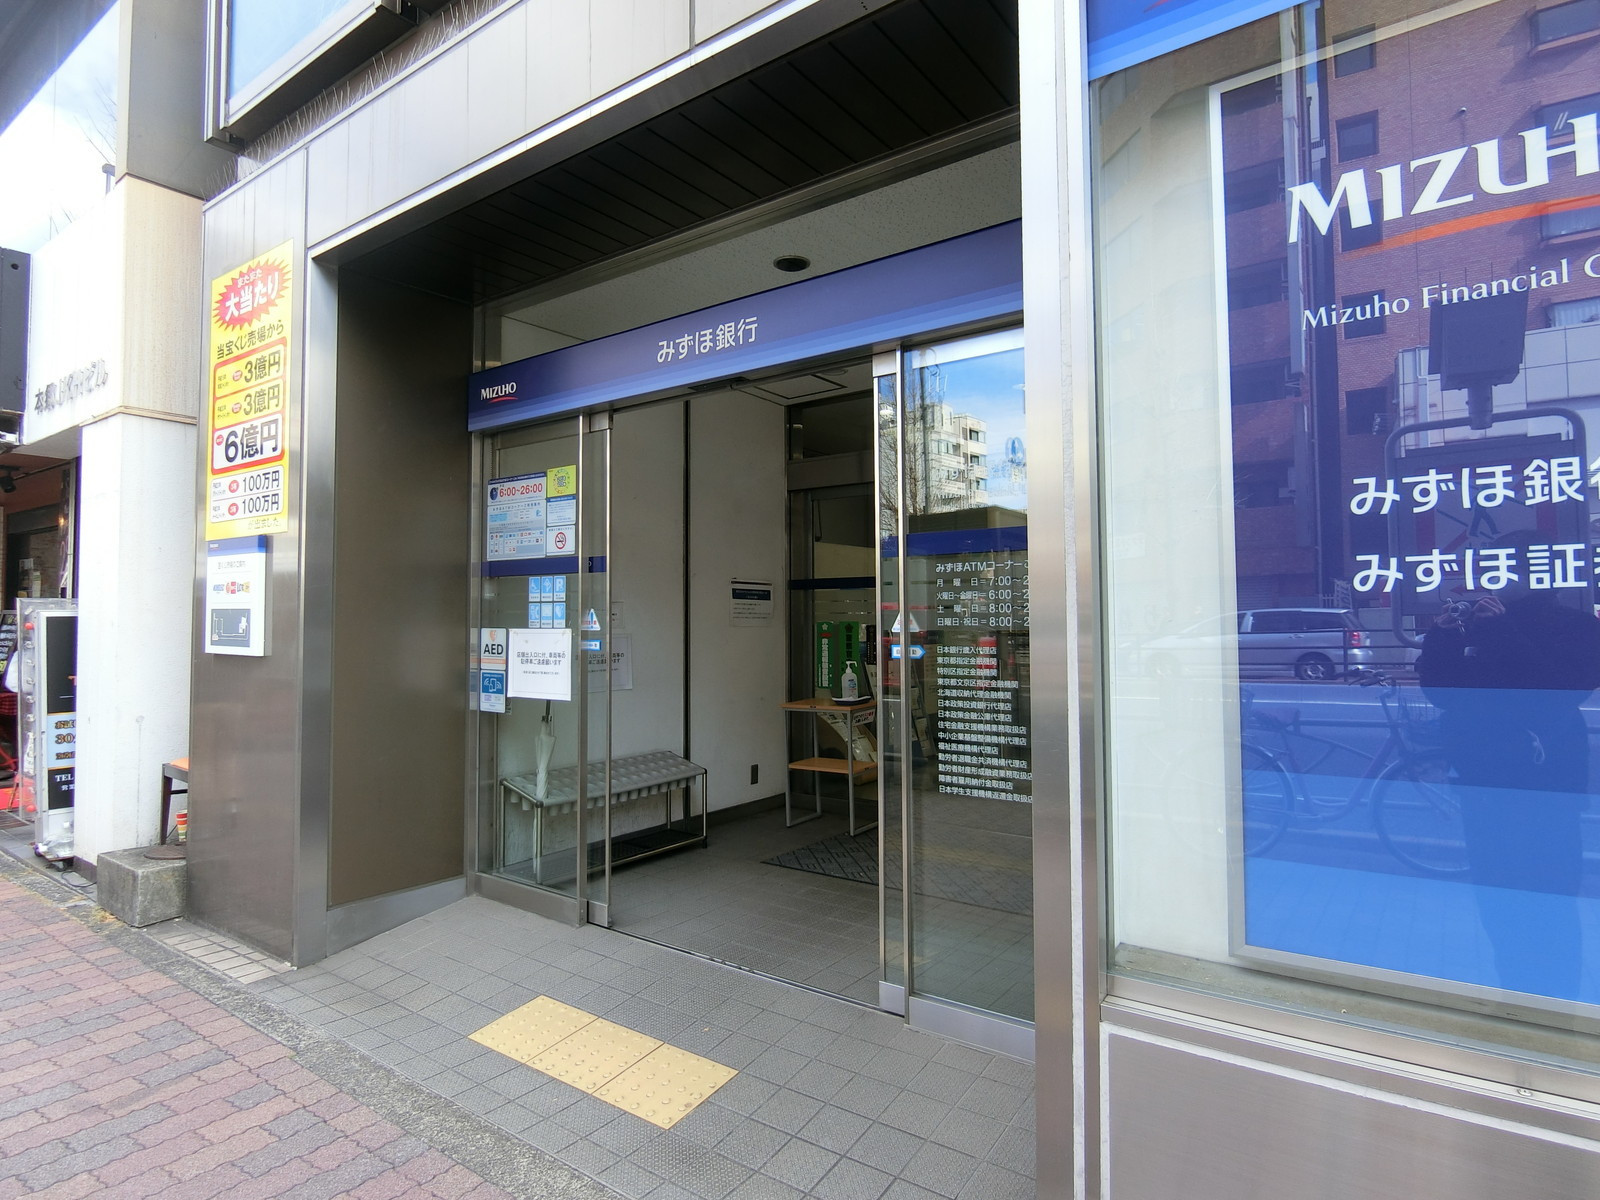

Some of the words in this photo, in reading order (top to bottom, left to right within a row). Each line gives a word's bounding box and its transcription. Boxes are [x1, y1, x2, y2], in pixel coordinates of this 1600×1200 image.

[1287, 112, 1600, 243] MIZUH
[225, 271, 279, 321] 大当たり
[1302, 294, 1410, 330] Mizuho
[1421, 258, 1570, 309] Financial
[217, 319, 284, 359] 当宝くじ売場から
[657, 316, 758, 362] みずほ銀行
[244, 350, 281, 383] 3億円
[243, 383, 281, 416] 3億円
[480, 382, 517, 400] MIZUHO
[225, 418, 279, 463] 6億円
[242, 470, 280, 493] 100万円
[241, 493, 280, 514] 100万円
[483, 642, 504, 656] AED
[937, 656, 997, 666] 東京都指定金融機関
[937, 667, 997, 677] 特別区指定金融機関
[937, 678, 1019, 689] 東京都文京区指定金融機関
[55, 773, 74, 782] TEL
